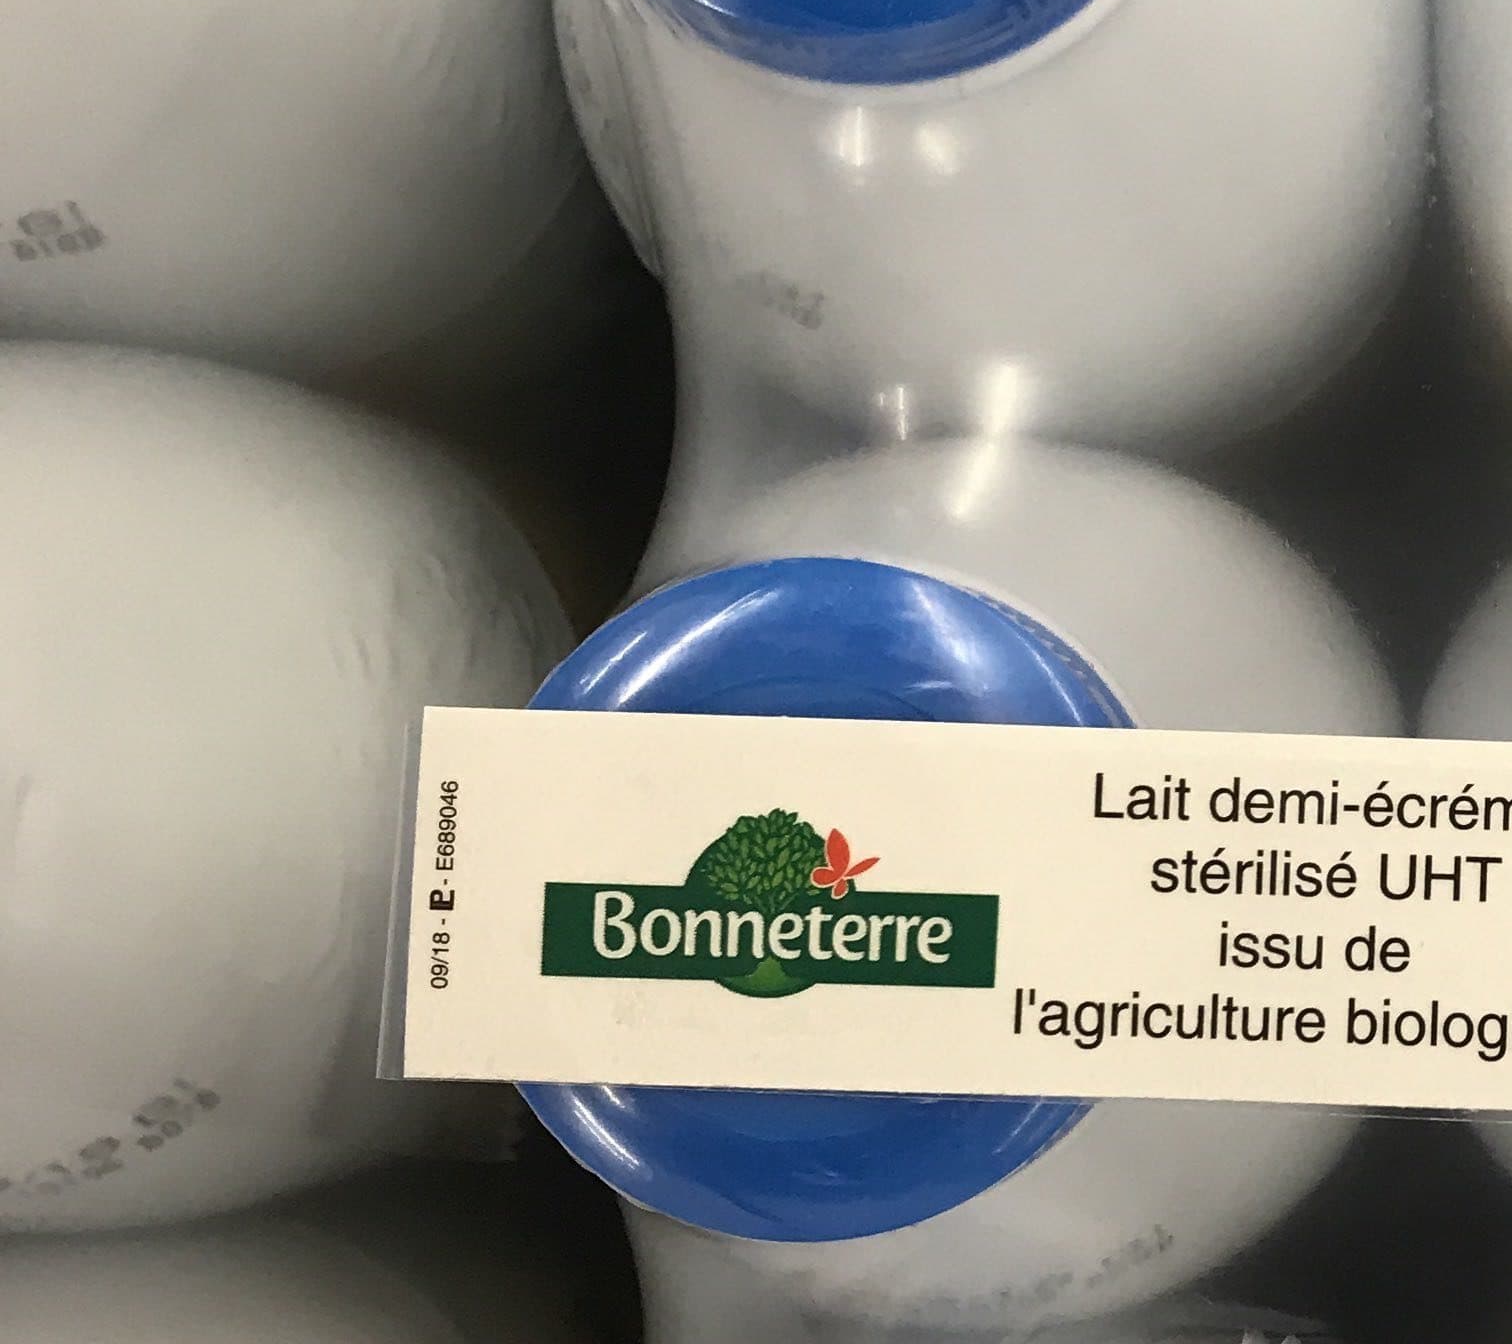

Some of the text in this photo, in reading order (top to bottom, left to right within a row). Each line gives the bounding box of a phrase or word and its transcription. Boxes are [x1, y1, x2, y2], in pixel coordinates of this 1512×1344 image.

[1094, 773, 1190, 821] Lait
[436, 781, 458, 870] E689046
[1151, 848, 1502, 902] stérilisé UHT
[592, 890, 954, 964] Bonneterre
[1220, 921, 1410, 972] issu de
[431, 933, 450, 989] 09/18
[1014, 988, 1325, 1049] l'agriculture
